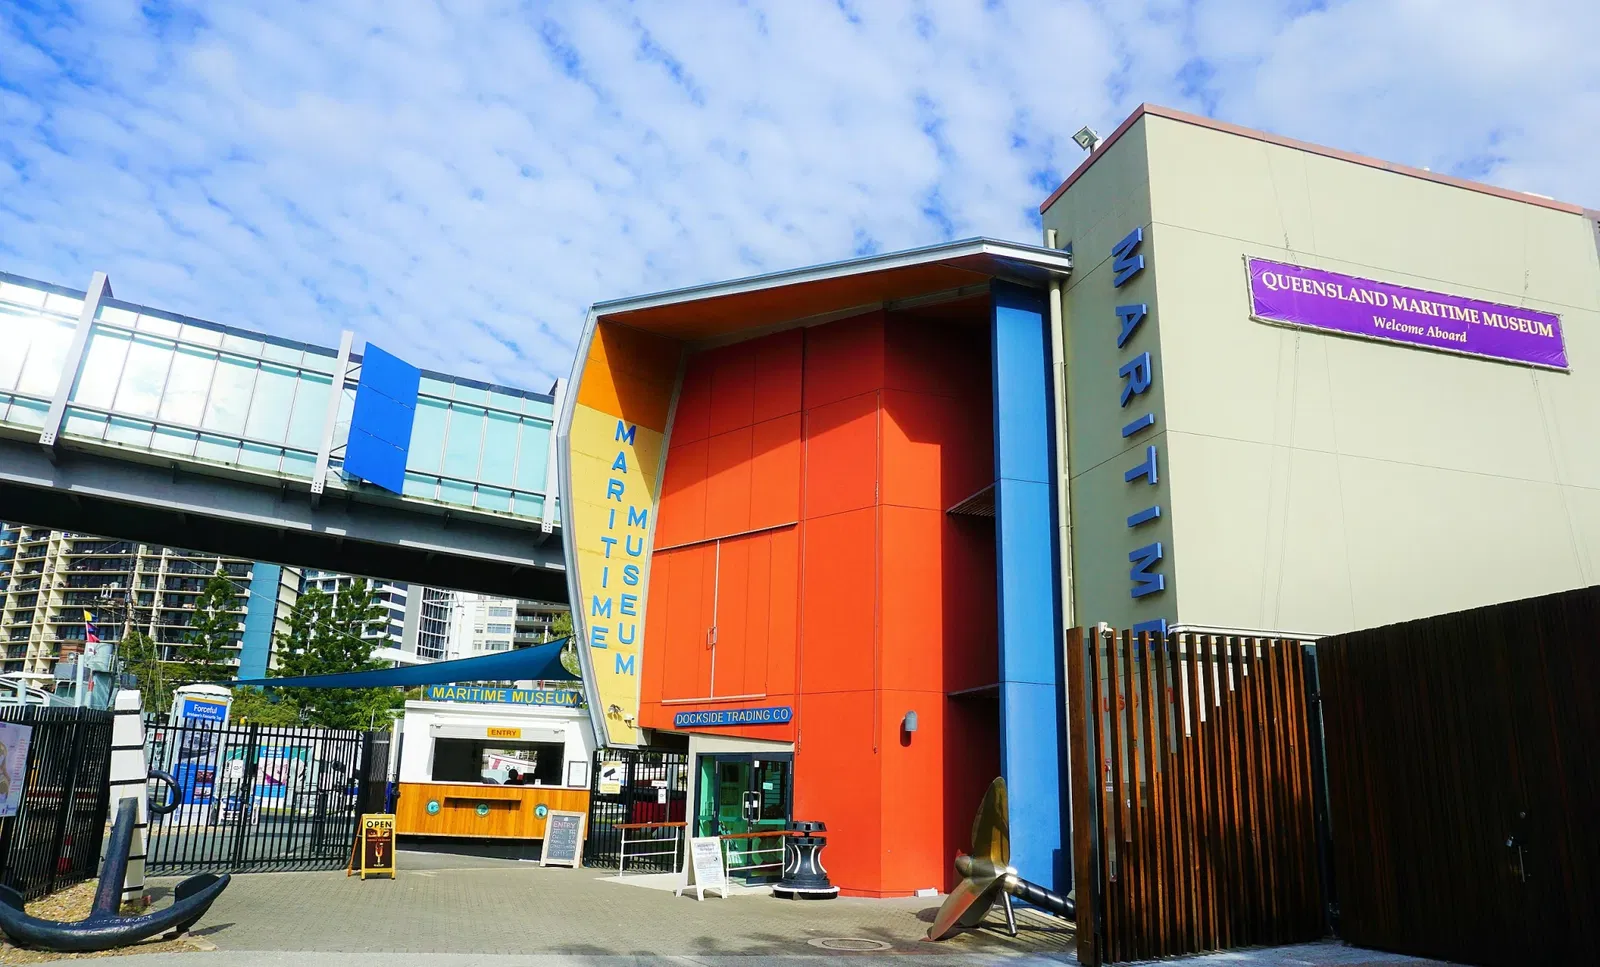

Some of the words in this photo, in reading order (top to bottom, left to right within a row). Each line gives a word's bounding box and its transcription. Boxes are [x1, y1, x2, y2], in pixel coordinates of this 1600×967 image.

[1261, 271, 1388, 307] QUEENSLAND
[1391, 294, 1480, 324] MARITIME
[1482, 311, 1555, 338] MUSEUM
[1373, 315, 1424, 335] Welcome
[1426, 325, 1468, 343] Aboard
[590, 419, 637, 649] MARITIME
[615, 505, 648, 676] MUSEUM
[432, 686, 507, 702] MARITIME
[511, 691, 577, 704] MUSEUM
[194, 704, 217, 713] Forceful
[676, 712, 724, 725] DOCKSIDE
[726, 710, 771, 722] TRADING
[773, 708, 789, 720] CO
[491, 729, 517, 737] ENTRY
[366, 820, 392, 828] OPEN
